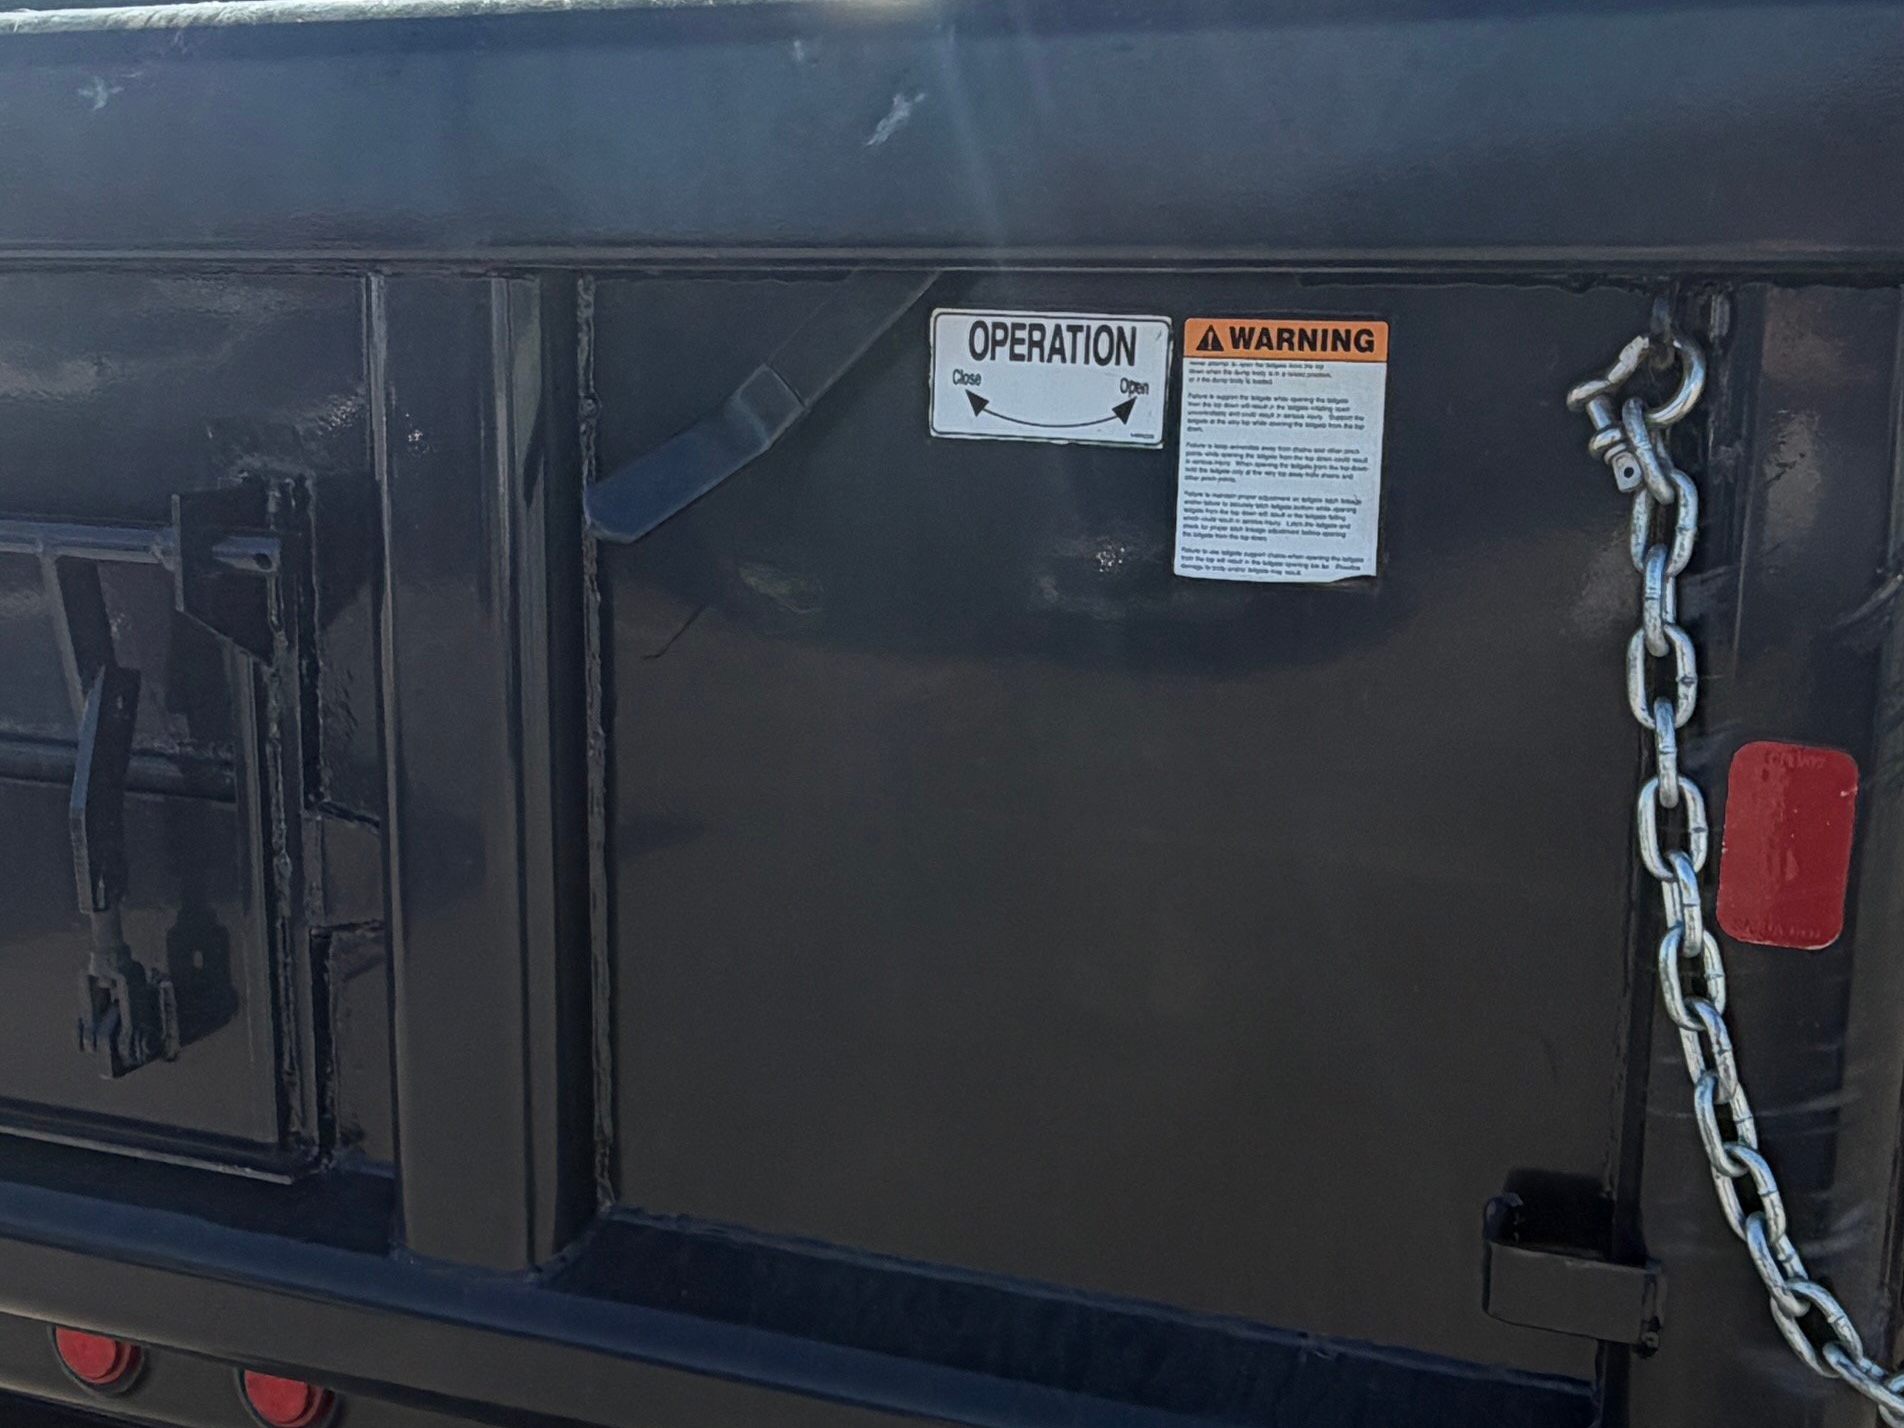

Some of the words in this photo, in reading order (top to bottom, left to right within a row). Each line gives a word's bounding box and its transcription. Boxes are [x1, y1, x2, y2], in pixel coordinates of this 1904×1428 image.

[968, 320, 1137, 366] OPERATION
[1229, 326, 1375, 353] WARNING
[952, 368, 982, 386] Close
[1119, 377, 1149, 398] Open
